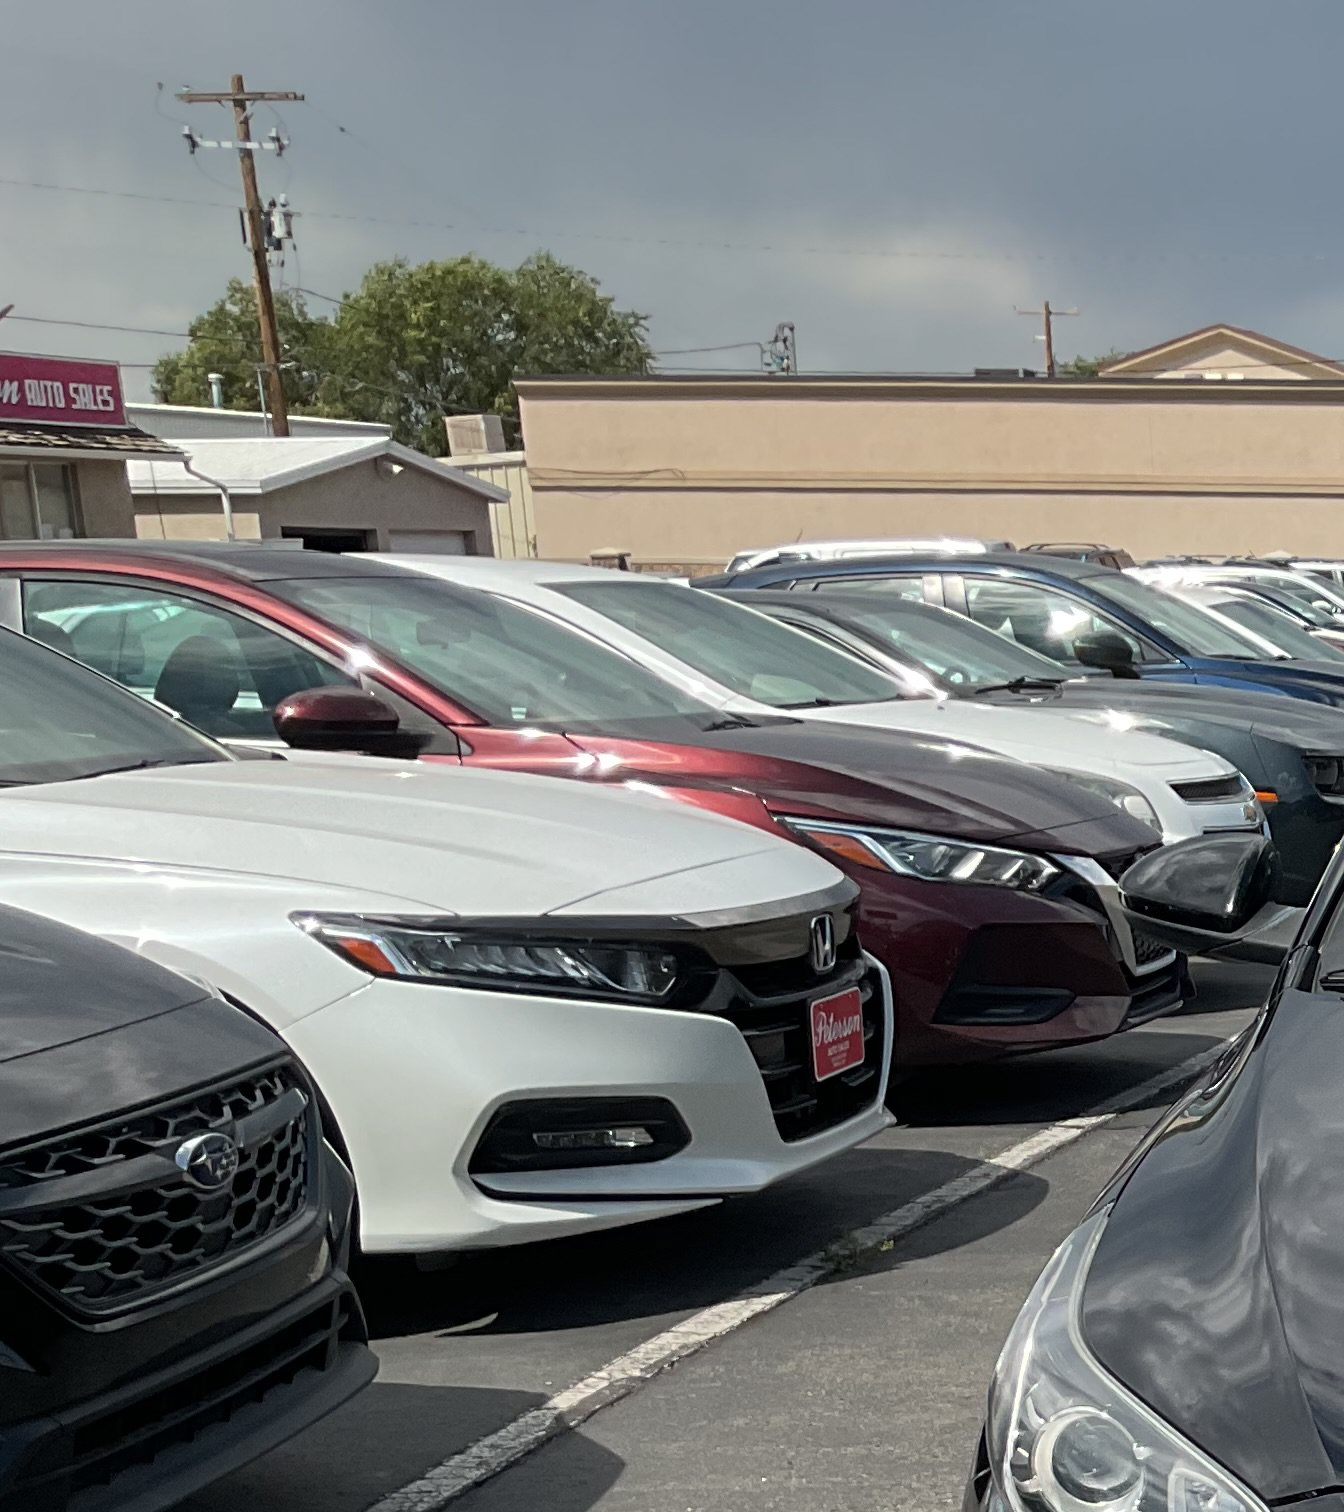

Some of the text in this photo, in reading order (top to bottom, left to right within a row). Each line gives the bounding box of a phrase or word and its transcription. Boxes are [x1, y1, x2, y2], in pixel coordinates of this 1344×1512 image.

[24, 379, 66, 408] AUTO
[69, 382, 115, 411] SALES
[814, 1011, 860, 1047] Peterson
